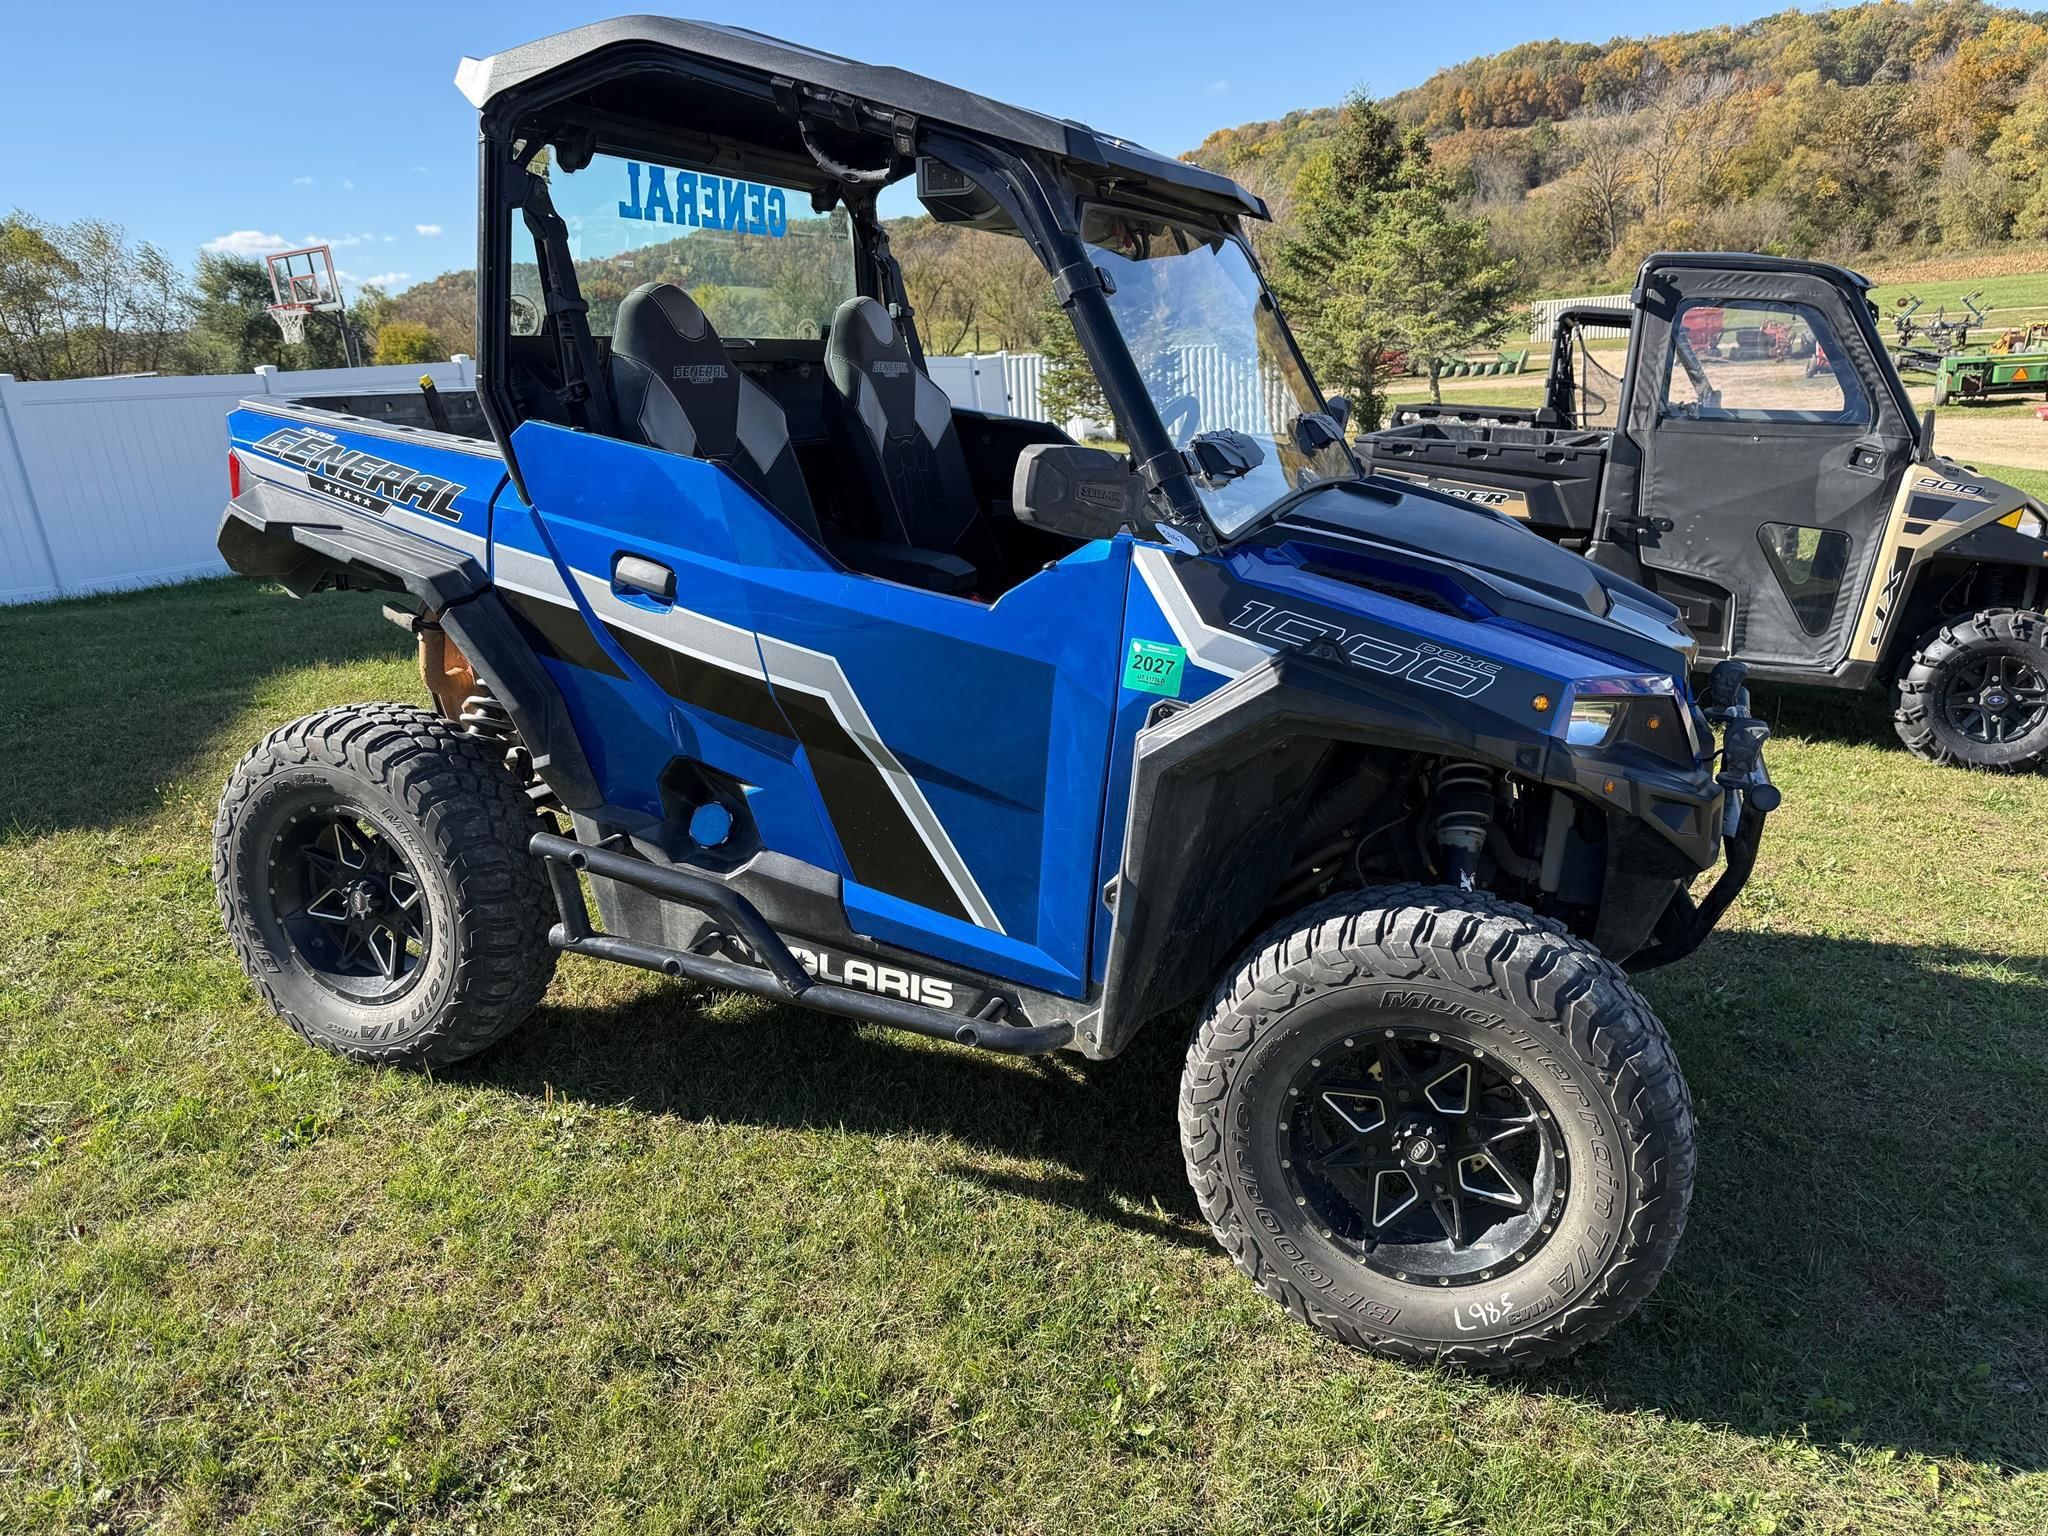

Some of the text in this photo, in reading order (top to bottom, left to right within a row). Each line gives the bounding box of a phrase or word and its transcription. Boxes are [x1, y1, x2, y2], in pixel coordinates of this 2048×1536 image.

[673, 365, 728, 379] GENERAL
[300, 426, 338, 442] POLARIS
[252, 427, 468, 523] GENERAL
[1916, 478, 1985, 495] 900
[1869, 558, 1903, 647] XP
[1132, 654, 1176, 676] 2027
[1228, 600, 1496, 699] 1000
[1415, 642, 1503, 675] DOHC
[755, 946, 954, 1009] OLARIS
[1380, 990, 1620, 1219] Mud-Terrain
[1230, 1072, 1401, 1327] BFGoodrich
[1548, 1224, 1611, 1299] T/A
[1454, 1291, 1515, 1331] 5867
[1507, 1294, 1554, 1326] KM3
